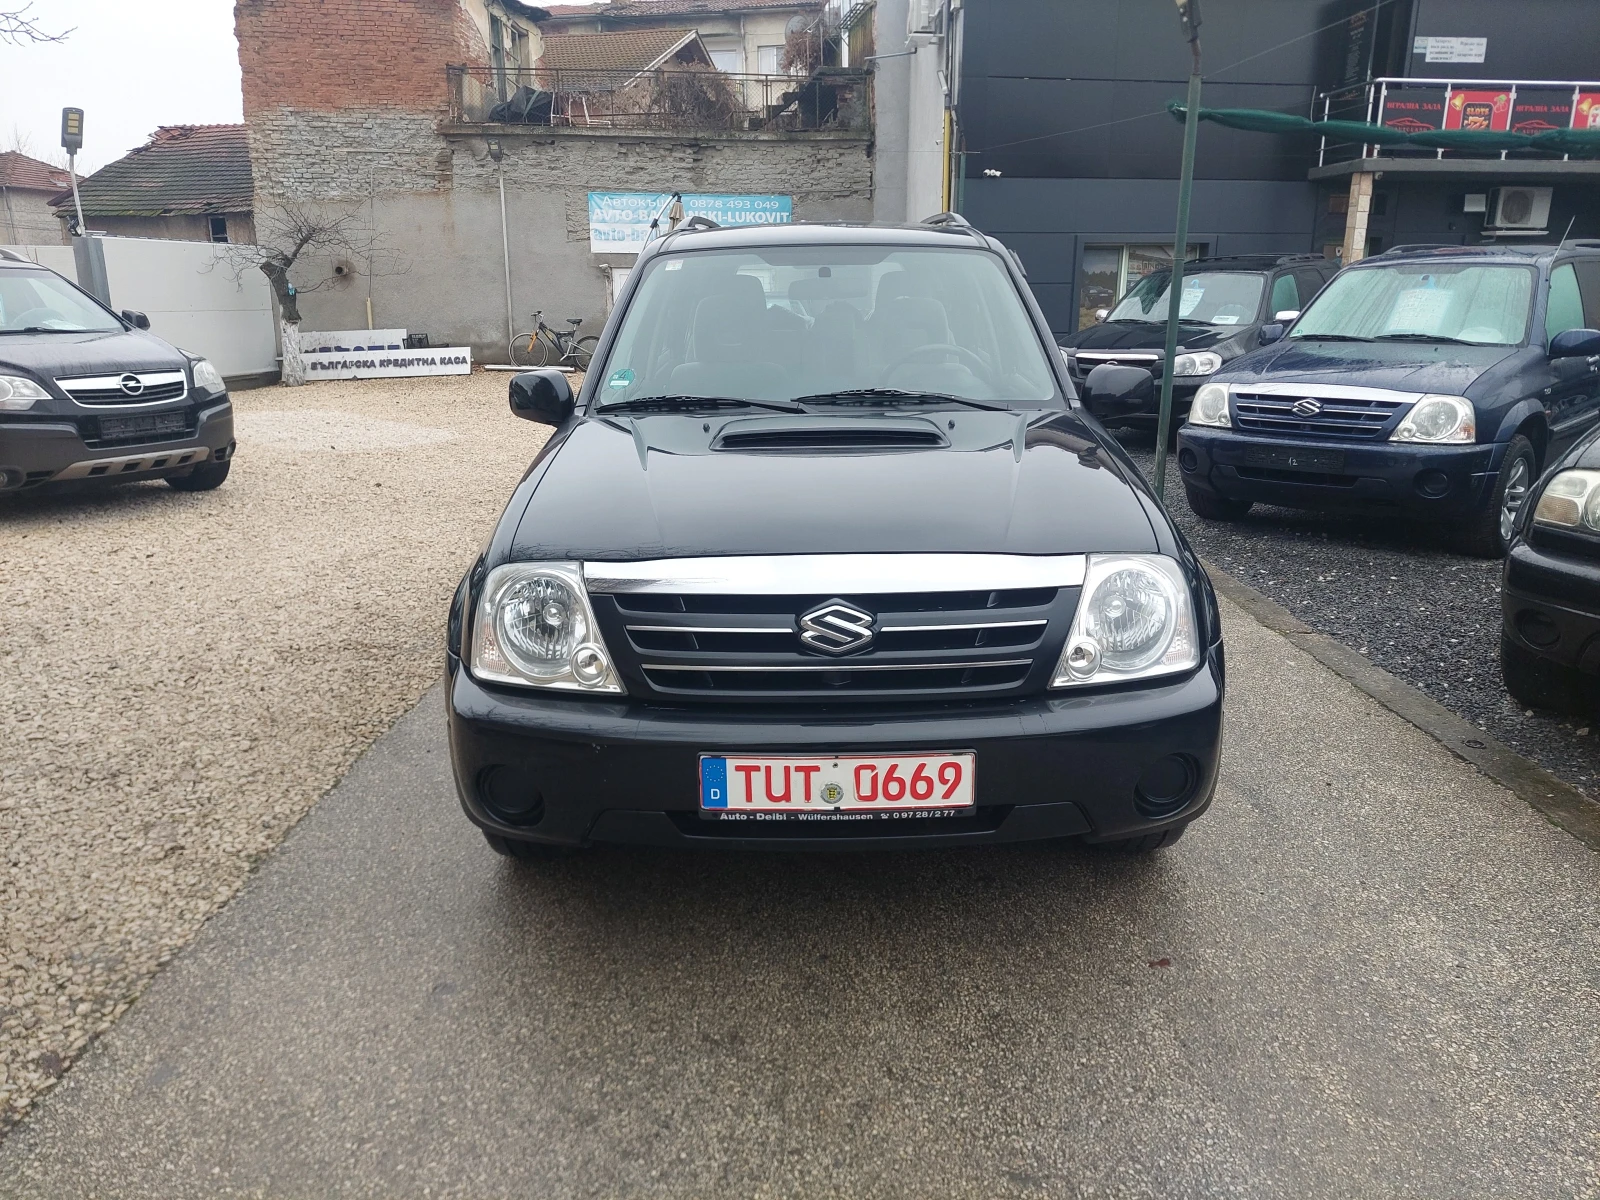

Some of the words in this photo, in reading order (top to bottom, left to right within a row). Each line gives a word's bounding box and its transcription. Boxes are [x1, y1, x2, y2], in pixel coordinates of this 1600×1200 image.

[1466, 107, 1489, 115] SLOTS
[690, 199, 723, 209] 0878
[726, 200, 751, 209] 493
[754, 200, 779, 209] 049
[379, 356, 437, 369] КРЕДИТНА
[440, 355, 468, 366] КАСА
[734, 765, 821, 803] TUT
[853, 761, 963, 802] 0669
[710, 788, 720, 799] D
[720, 812, 747, 821] Auto
[798, 811, 874, 821] Wülfershausen
